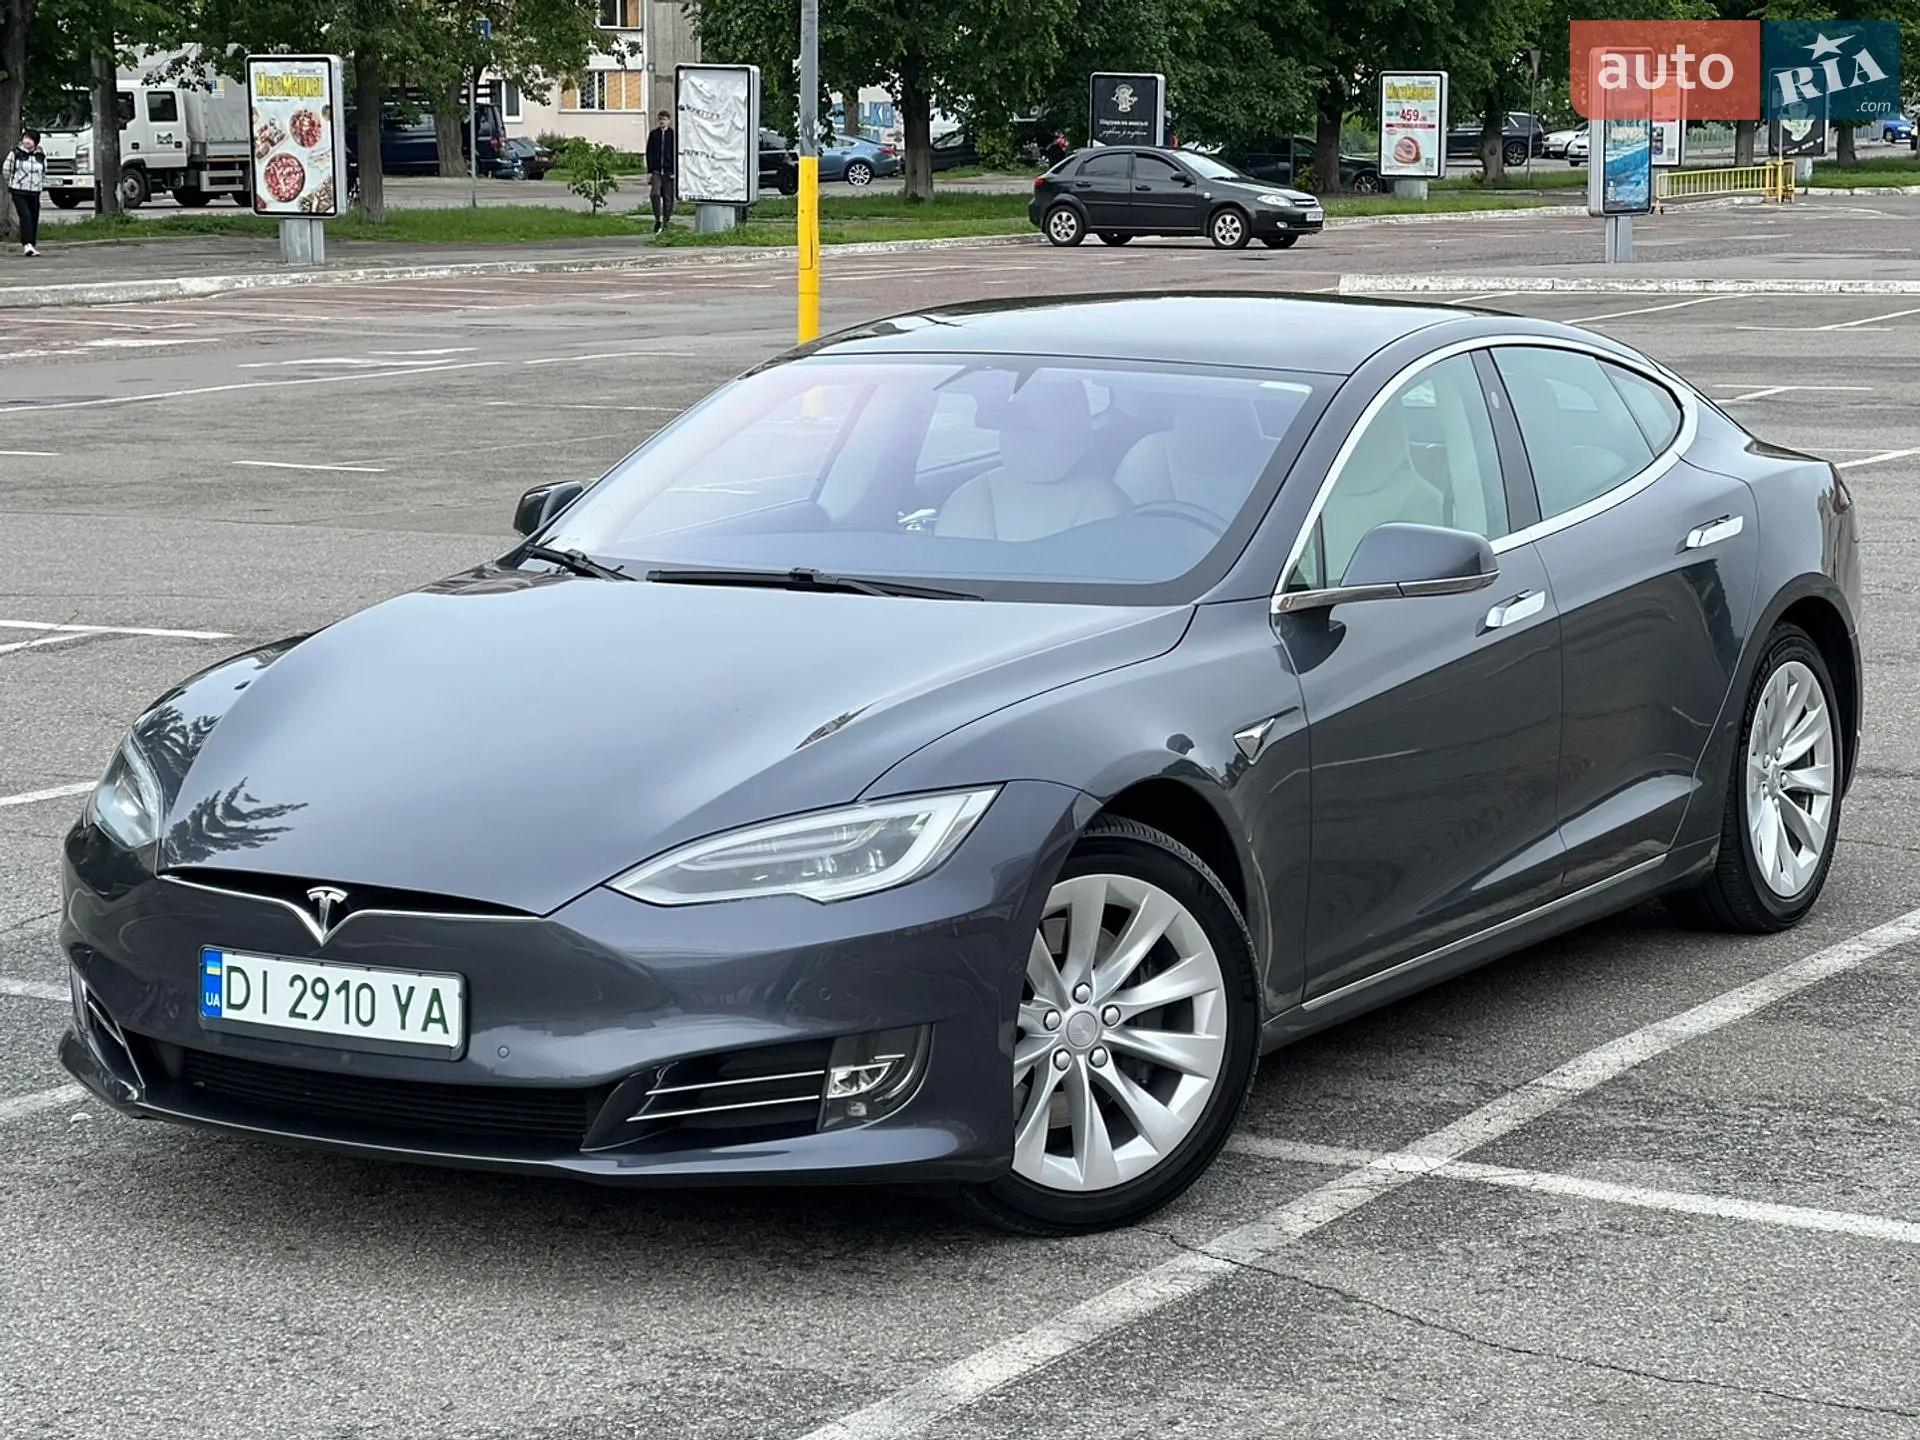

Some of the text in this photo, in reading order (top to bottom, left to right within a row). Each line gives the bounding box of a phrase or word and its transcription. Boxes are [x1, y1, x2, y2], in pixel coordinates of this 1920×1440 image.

[1400, 109, 1419, 121] 459
[205, 992, 221, 1008] UA
[226, 965, 449, 1034] DI 2910 YA
